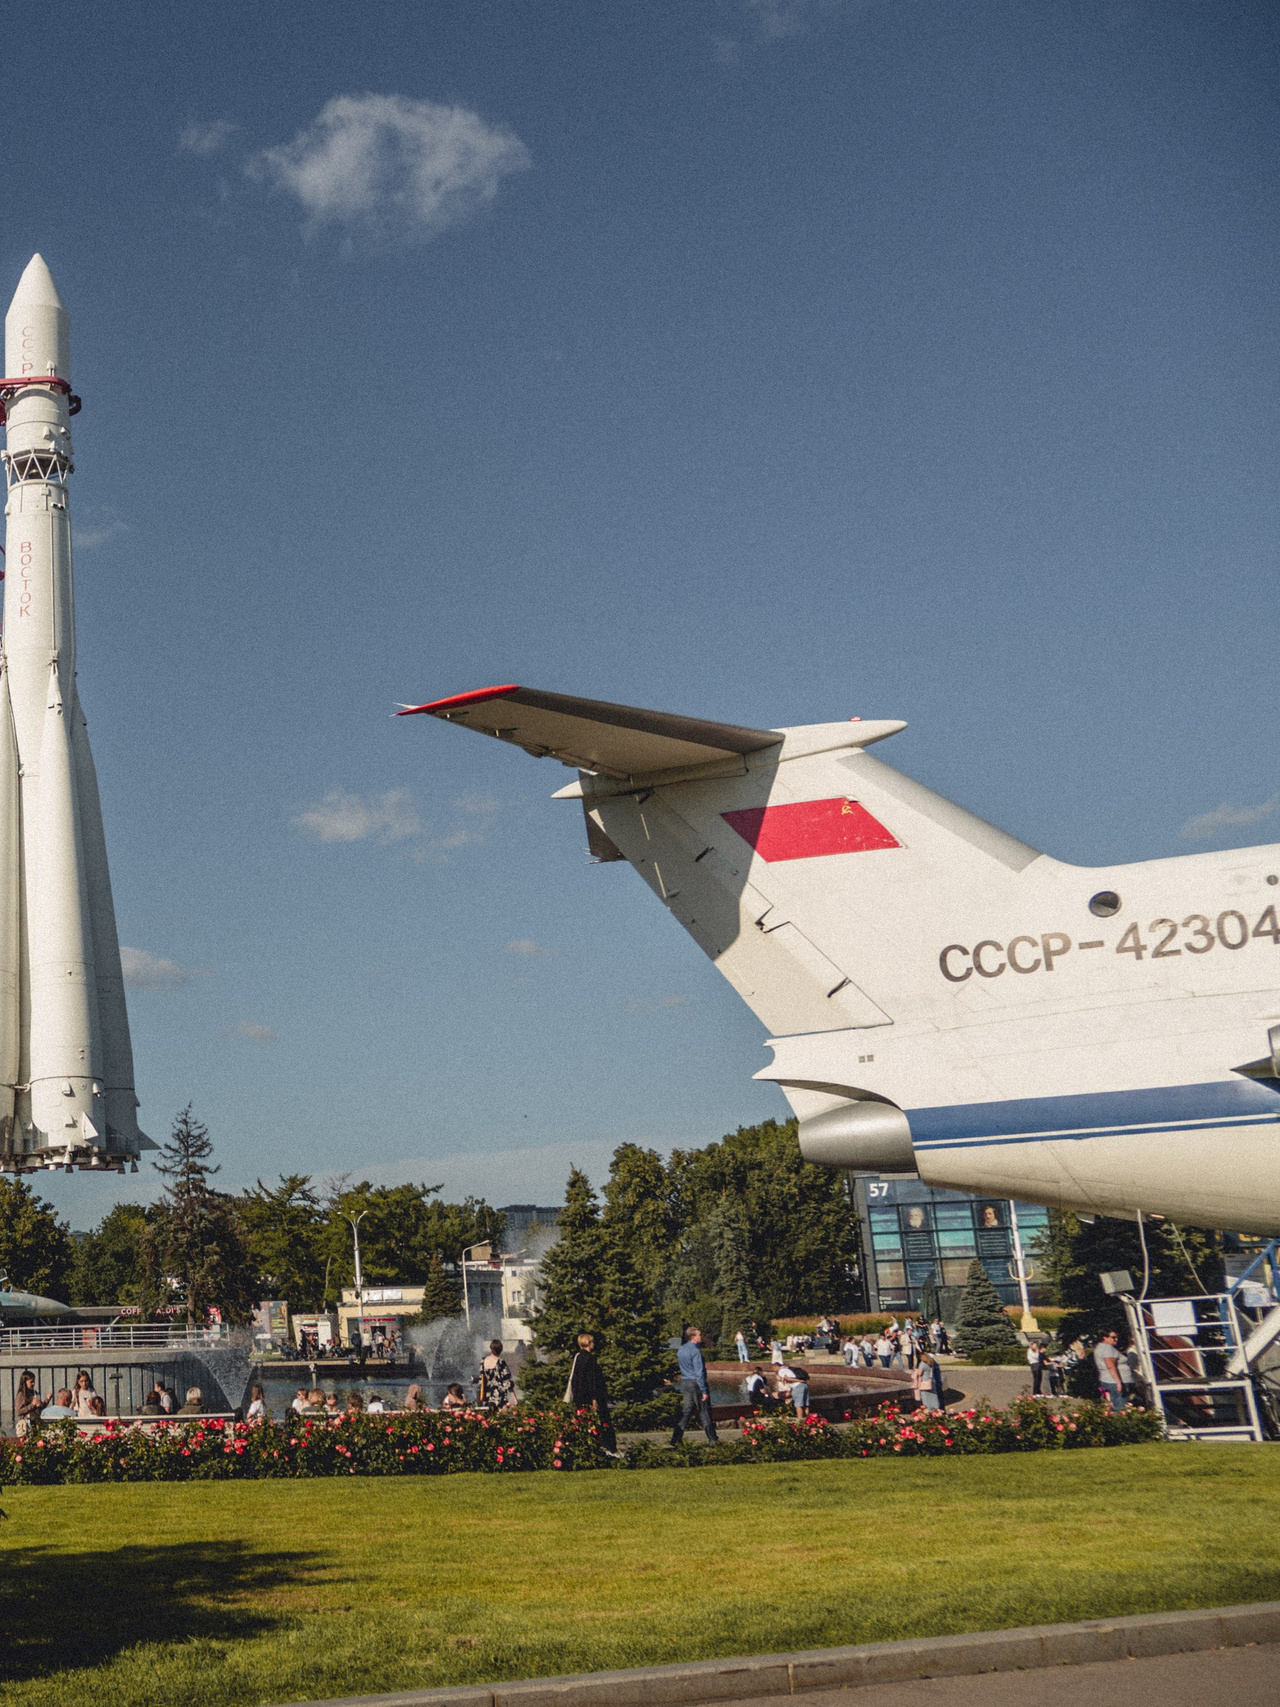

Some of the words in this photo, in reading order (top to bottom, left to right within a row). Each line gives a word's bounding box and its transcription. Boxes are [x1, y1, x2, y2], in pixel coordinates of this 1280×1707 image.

[20, 541, 32, 617] ВОСТОК
[939, 904, 1280, 983] СССР-42304
[869, 1182, 888, 1197] 57
